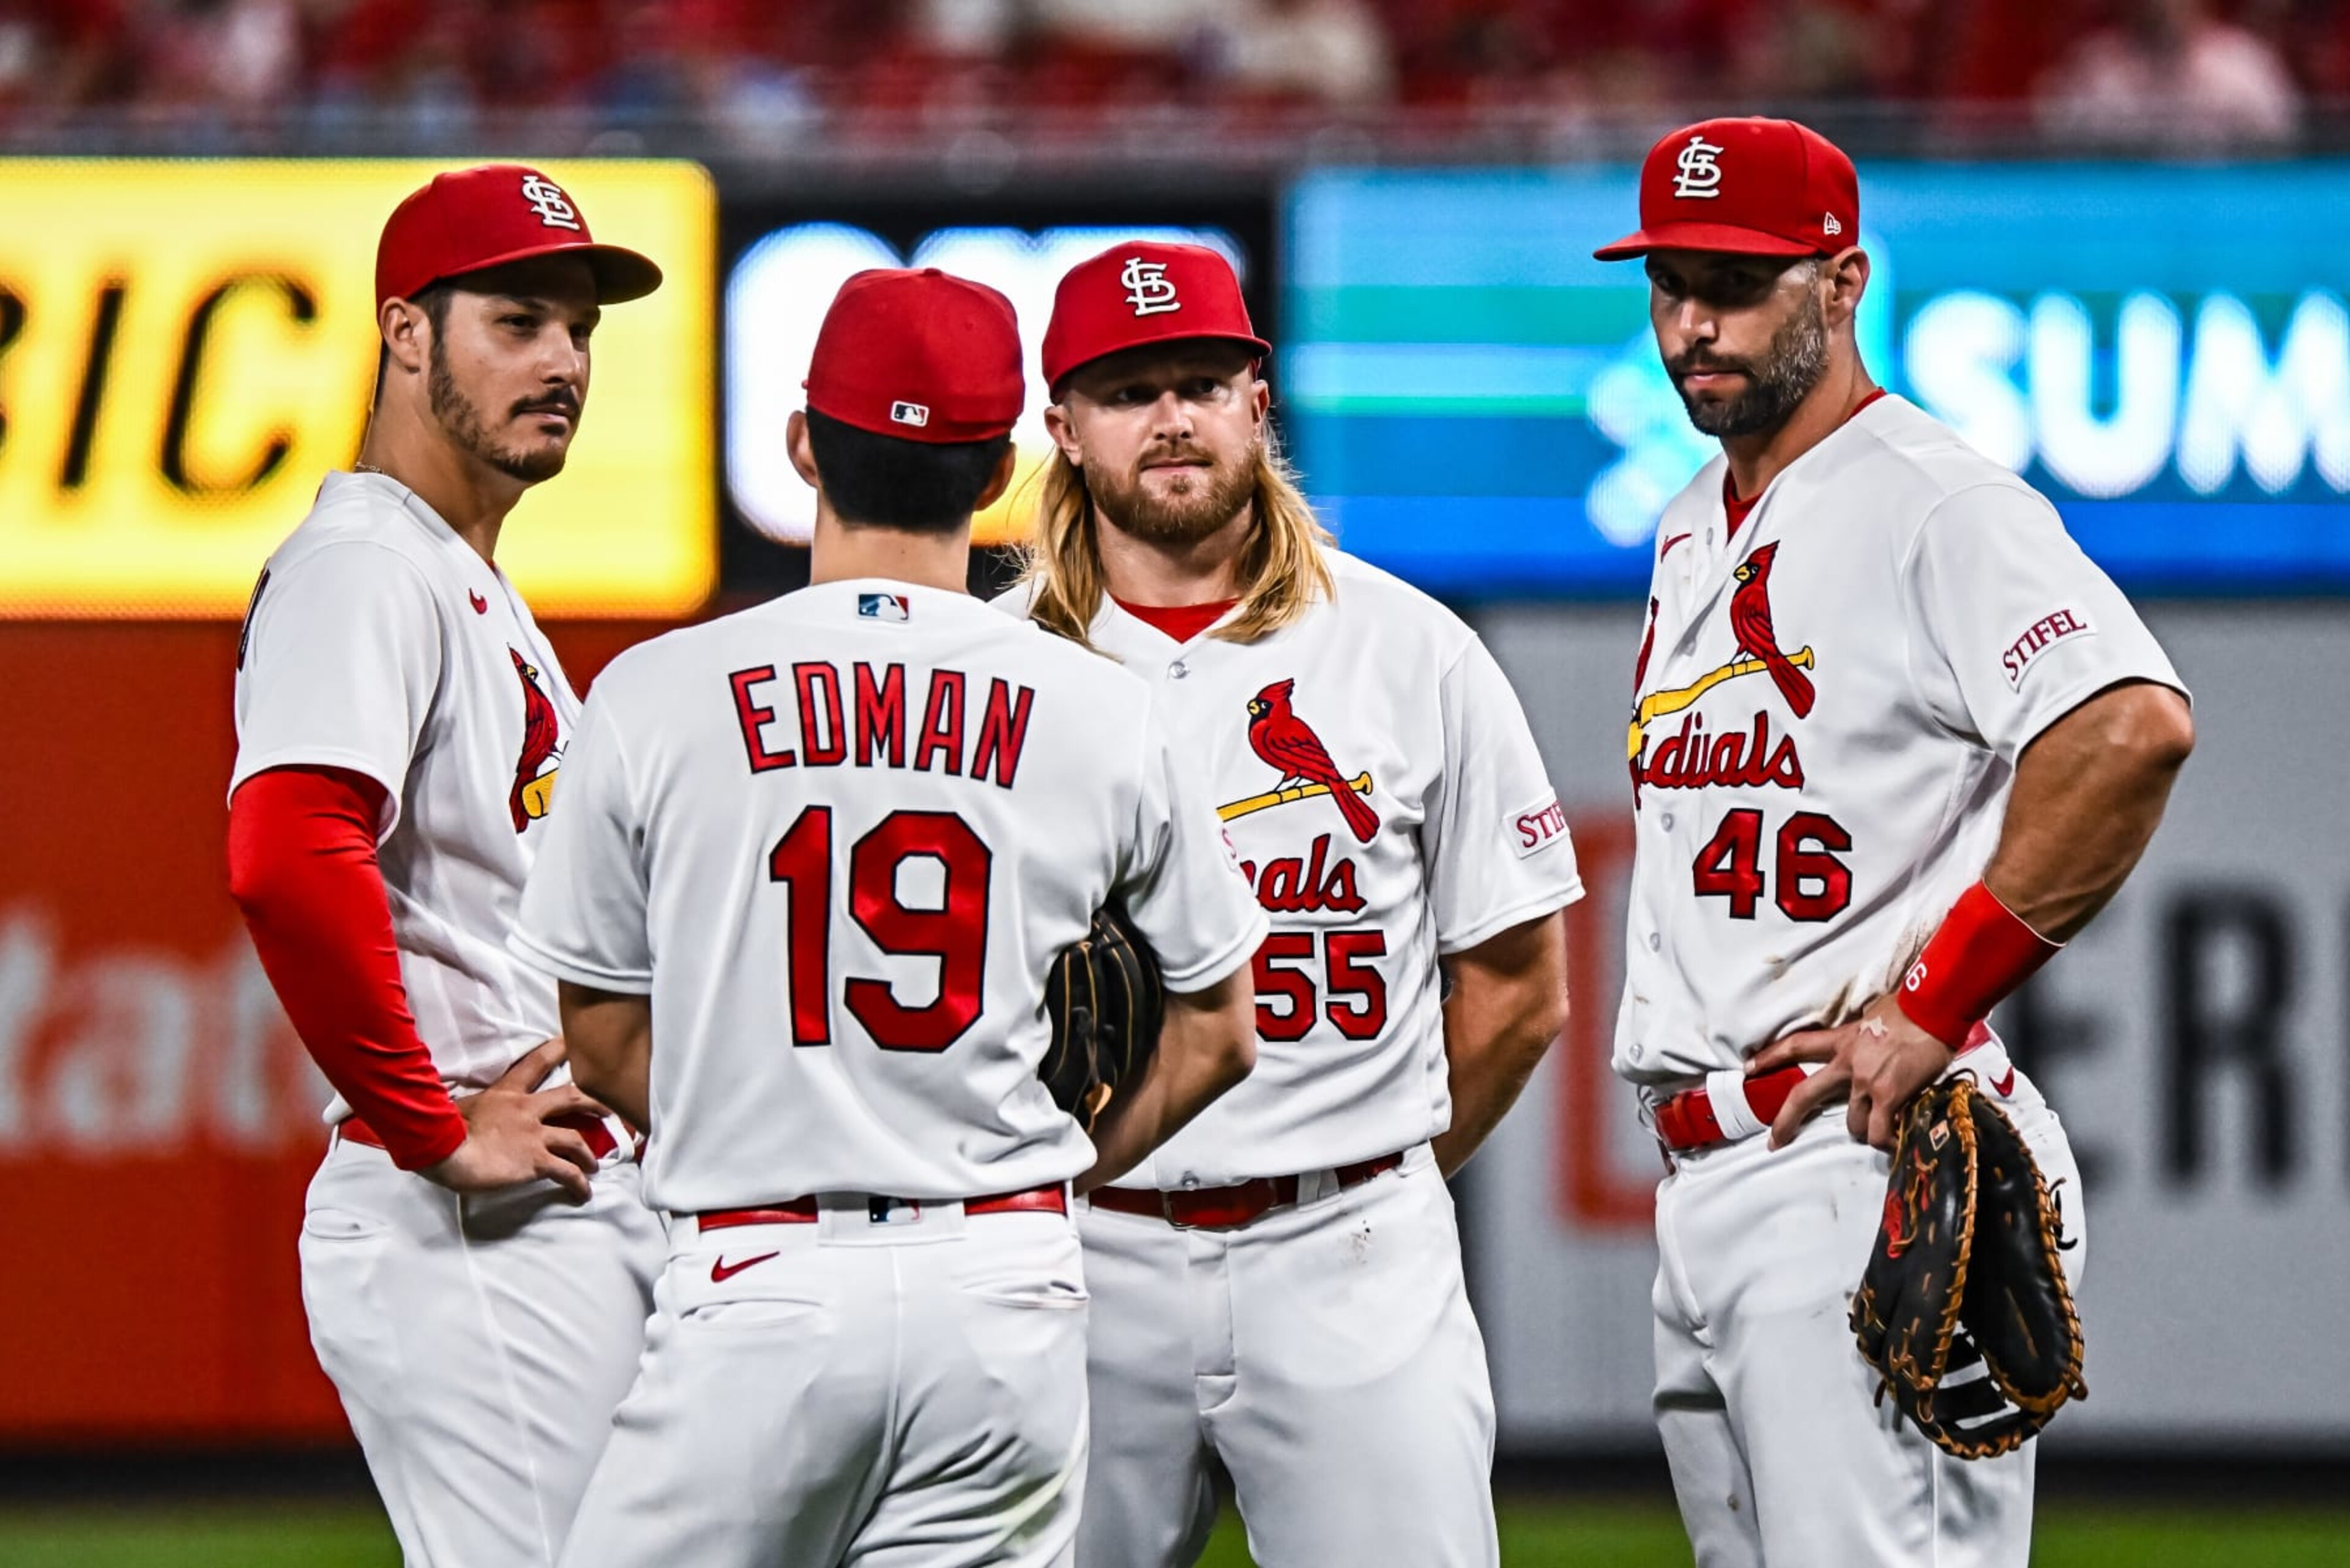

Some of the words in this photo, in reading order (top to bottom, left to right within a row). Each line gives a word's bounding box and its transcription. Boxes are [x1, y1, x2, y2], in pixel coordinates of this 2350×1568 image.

[2003, 609, 2087, 682] STIFEL
[728, 661, 1035, 790] EDMAN
[1239, 832, 1367, 914] als
[1692, 807, 1853, 923] 46
[769, 805, 993, 1053] 19
[1251, 929, 1387, 1042] 55
